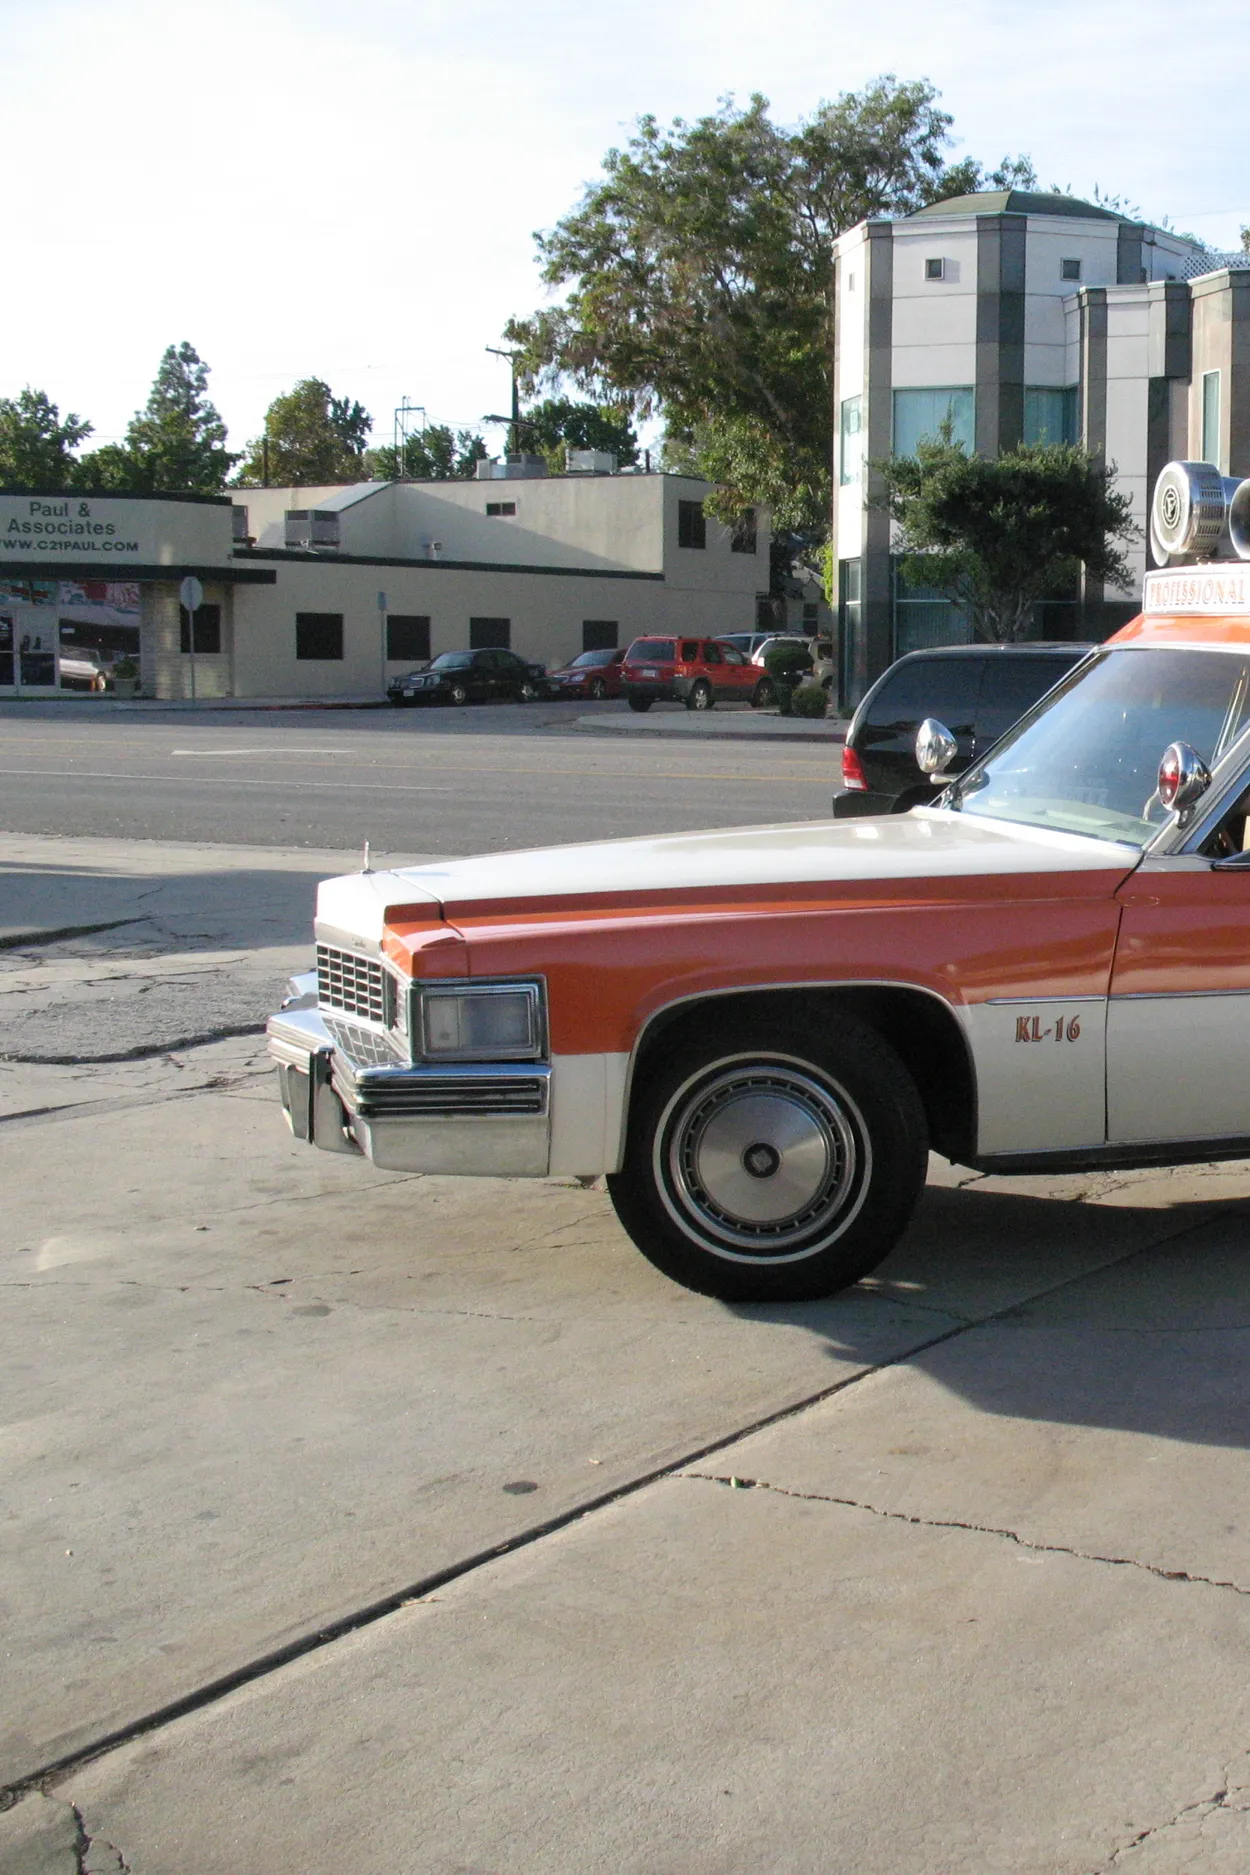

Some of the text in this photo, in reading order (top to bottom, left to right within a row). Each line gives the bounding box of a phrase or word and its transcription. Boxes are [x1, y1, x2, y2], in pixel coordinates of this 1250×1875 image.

[29, 501, 91, 518] Paul &
[7, 518, 116, 535] Associates
[0, 539, 139, 552] WW.C21PAUL.COM
[1149, 579, 1246, 606] PROFESSIONAL
[1015, 1014, 1081, 1042] KL-16
